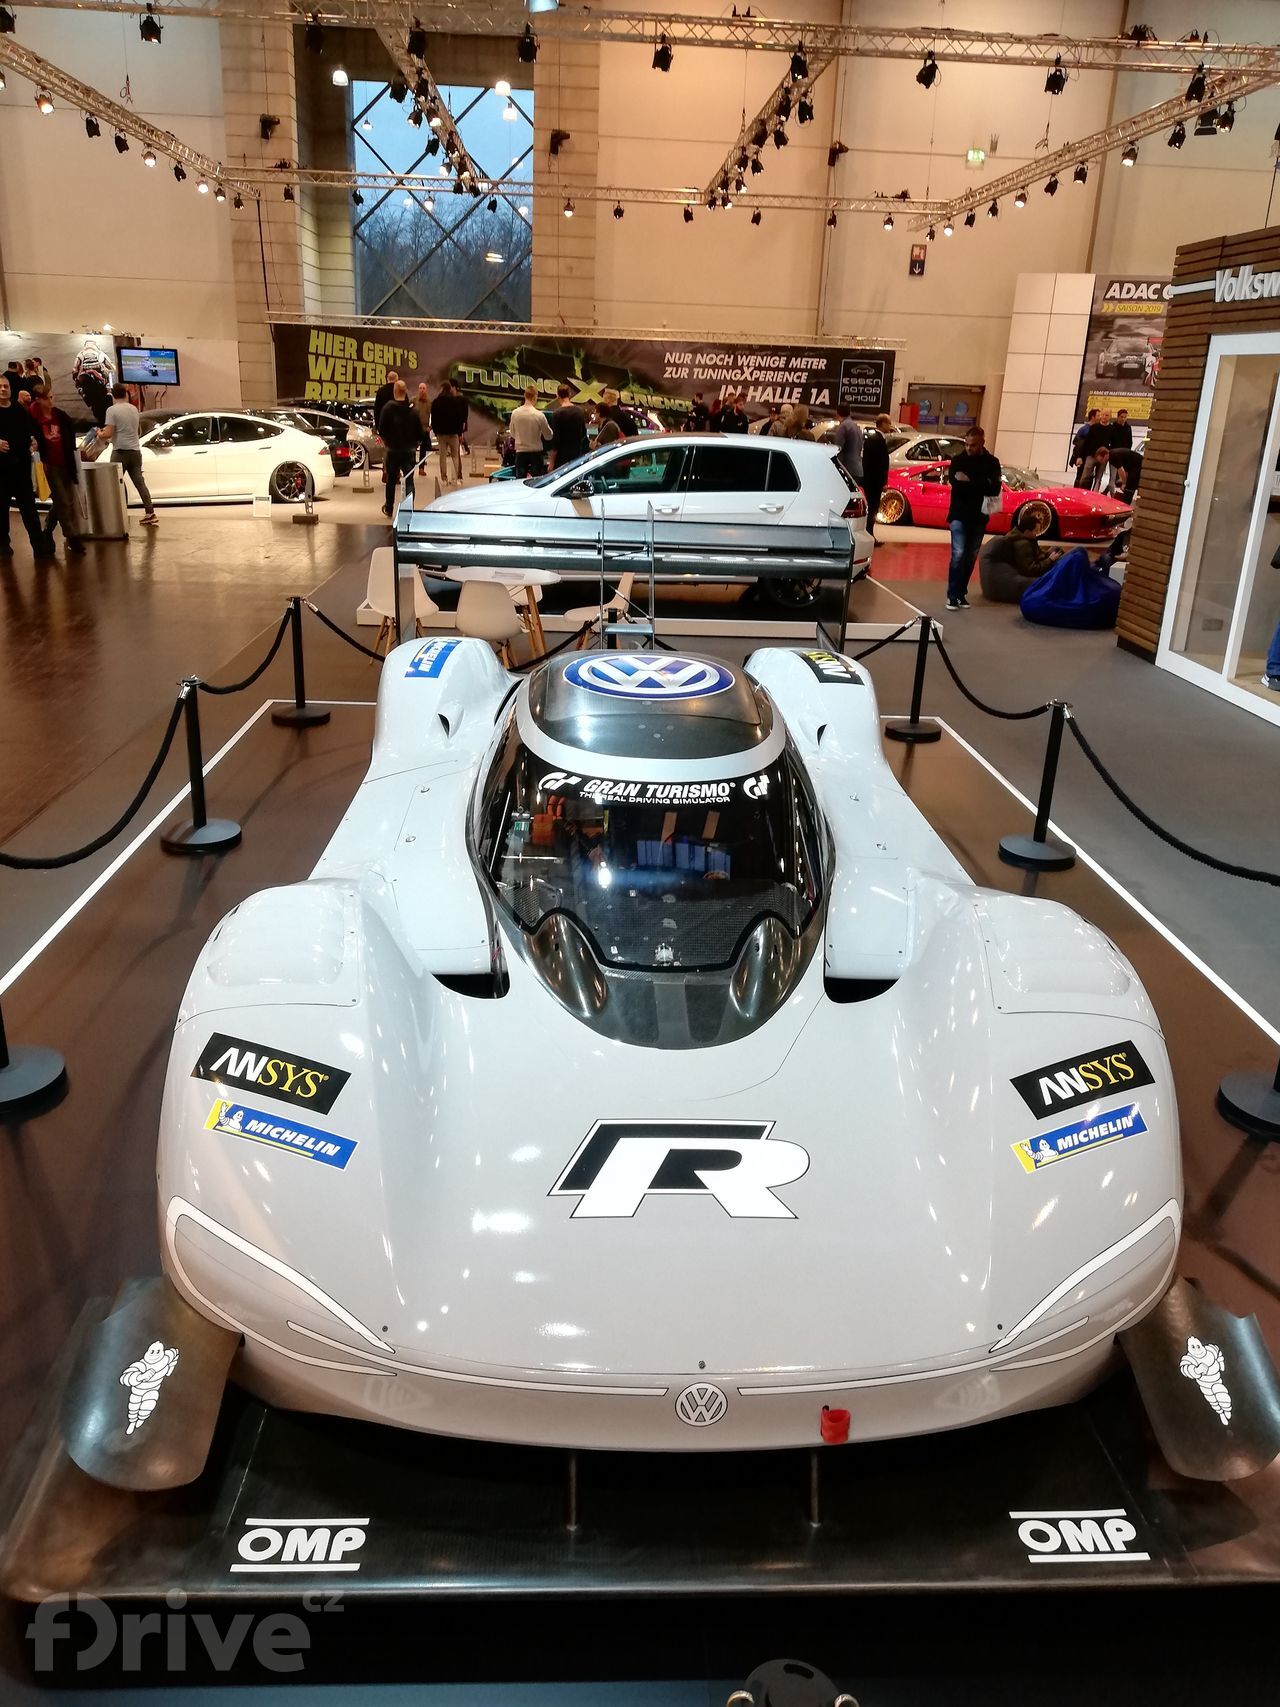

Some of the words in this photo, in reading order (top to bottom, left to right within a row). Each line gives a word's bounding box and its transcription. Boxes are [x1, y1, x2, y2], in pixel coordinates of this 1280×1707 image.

[1105, 283, 1161, 300] ADAC
[1117, 304, 1143, 312] SAISON
[1144, 304, 1161, 312] 2019
[309, 329, 358, 360] HIER
[363, 341, 418, 370] GEHT'S
[308, 354, 387, 385] WEITER
[664, 352, 692, 365] NUR
[695, 353, 733, 366] NOCH
[737, 355, 786, 368] WENIGE
[789, 357, 827, 370] METER
[663, 367, 689, 379] ZUR
[693, 366, 808, 384] TUNINGXPERIENCE
[843, 377, 881, 386] ESSEN
[747, 386, 802, 404] HALLE
[809, 388, 831, 405] 1A
[842, 386, 881, 394] MOTOR
[583, 780, 645, 796] GRAN
[629, 796, 671, 804] DRIVING
[210, 1046, 324, 1098] ANSYS
[1038, 1053, 1134, 1106] ANSYS
[245, 1120, 341, 1157] MICHELIN
[1056, 1115, 1134, 1151] MICHELIN
[238, 1527, 366, 1562] OMP
[1018, 1518, 1137, 1553] OMP
